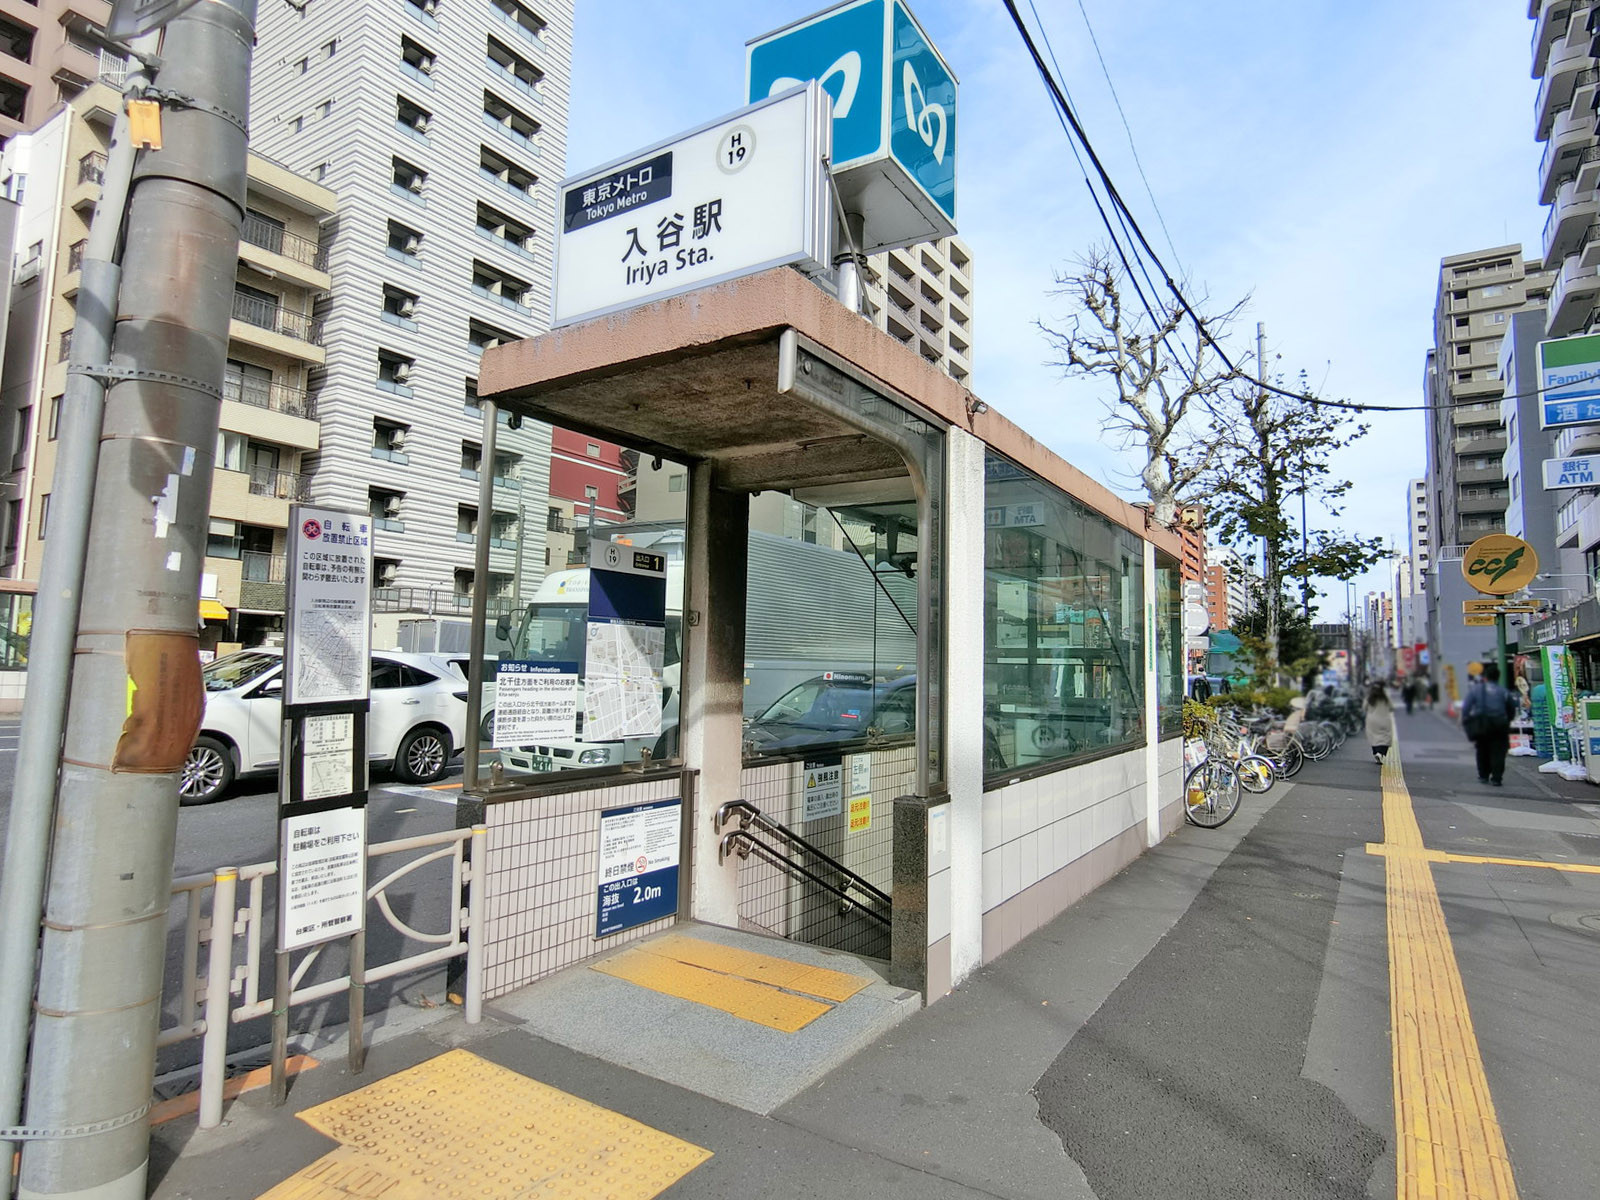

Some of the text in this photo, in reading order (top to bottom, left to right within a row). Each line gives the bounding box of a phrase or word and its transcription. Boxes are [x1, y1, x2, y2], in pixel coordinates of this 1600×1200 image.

[730, 133, 742, 148] H
[727, 146, 747, 165] 19
[582, 166, 653, 207] 東京メトロ
[586, 190, 648, 221] Tokyo Metro
[621, 198, 723, 264] 入谷駅
[625, 245, 715, 287] Iriya Sta.
[1562, 460, 1590, 472] 銀行
[1558, 471, 1593, 485] ATM
[323, 533, 368, 546] 放置禁止区域
[609, 555, 617, 563] 19
[654, 557, 660, 570] 1
[500, 663, 528, 672] お知らせ
[833, 673, 866, 681] Hinomaru
[293, 826, 321, 839] 自転車は
[292, 832, 360, 852] 駐輪場をご利用下さい
[604, 861, 635, 879] 終日禁煙
[603, 877, 639, 894] この出入口は
[602, 892, 620, 908] 海抜
[633, 886, 662, 904] 2.0m
